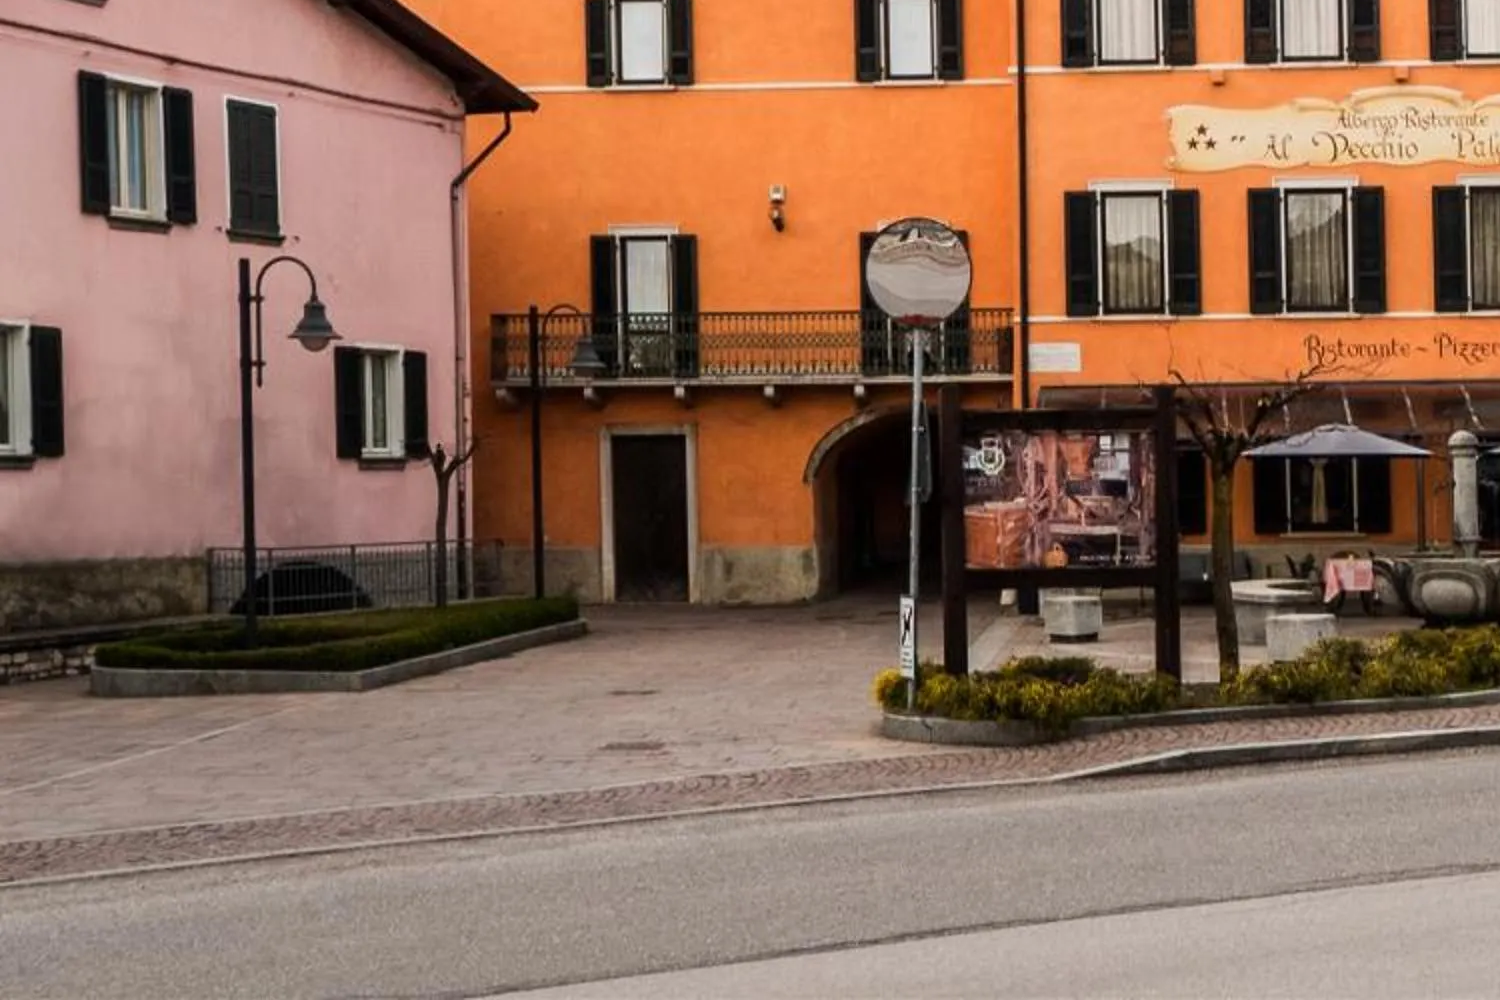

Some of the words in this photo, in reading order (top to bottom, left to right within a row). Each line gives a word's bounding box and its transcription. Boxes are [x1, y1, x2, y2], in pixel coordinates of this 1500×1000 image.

[1335, 108, 1398, 136] Albergo
[1401, 105, 1489, 132] Ristorante
[1311, 130, 1420, 164] Vecchio
[1303, 332, 1412, 367] Ristorante
